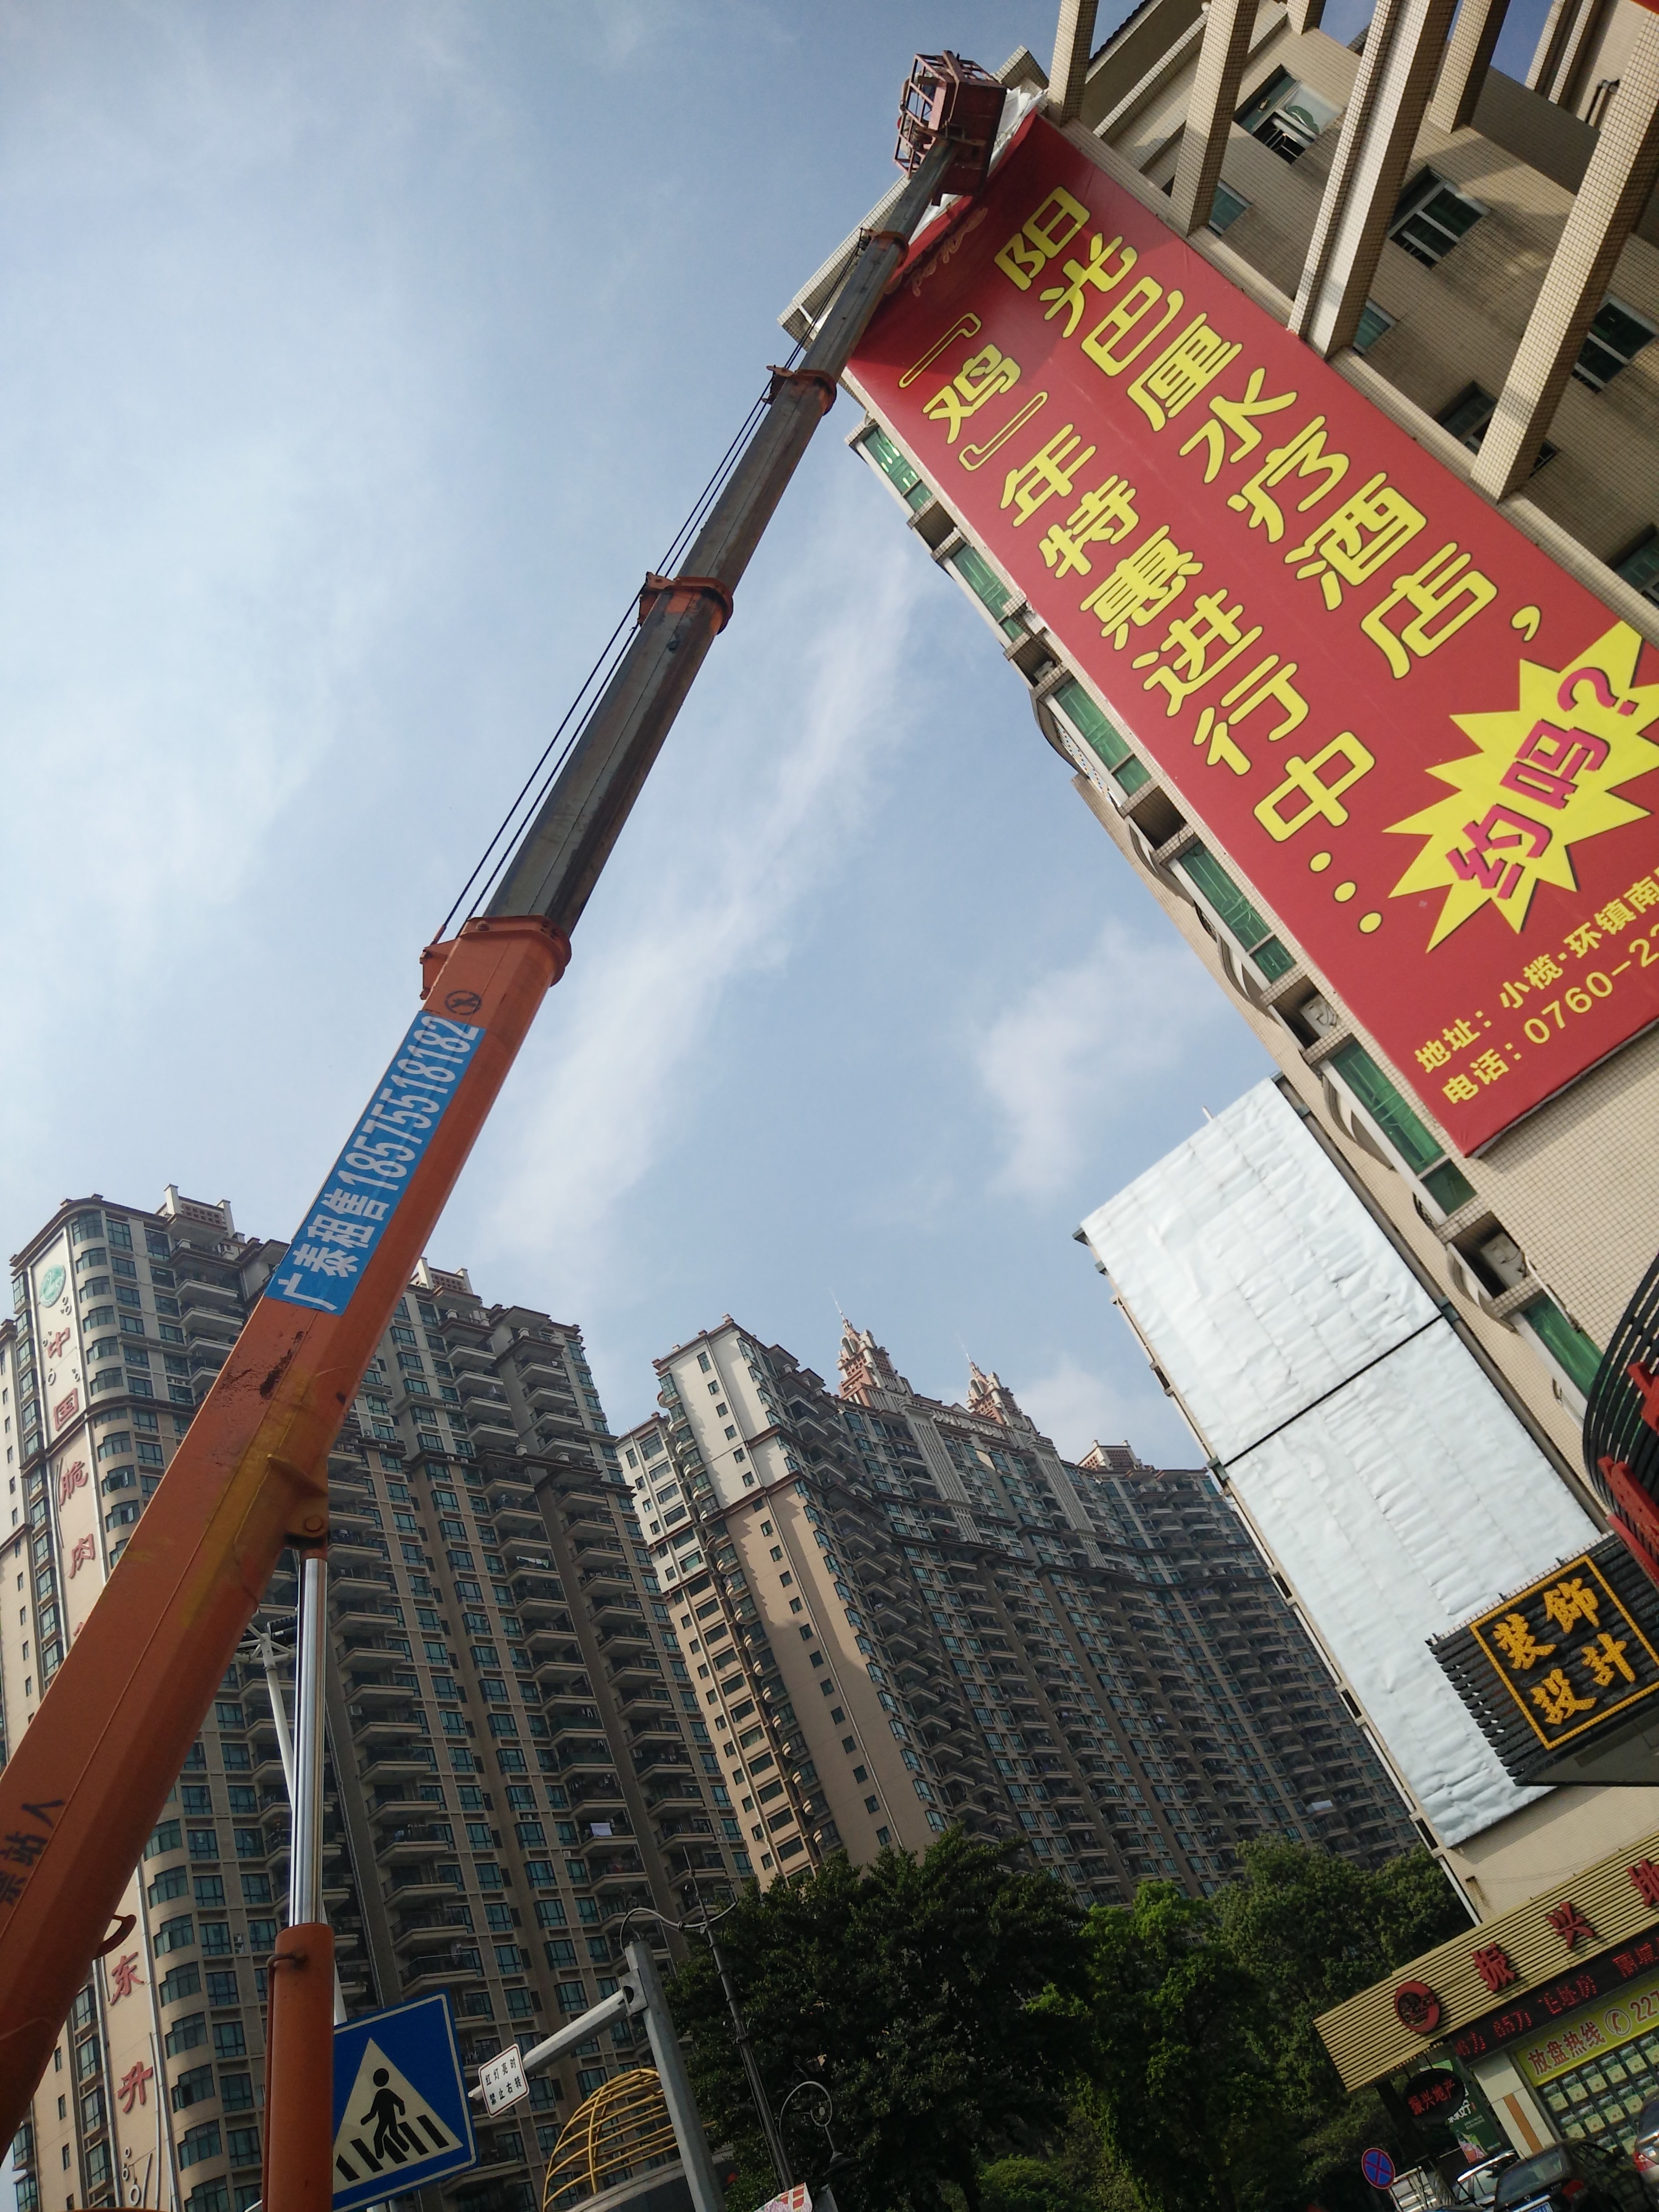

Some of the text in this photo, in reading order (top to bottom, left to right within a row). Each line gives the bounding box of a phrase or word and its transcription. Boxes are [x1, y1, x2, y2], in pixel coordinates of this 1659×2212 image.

[1414, 866, 1659, 1074] 地址：小榄·环镇南
[1528, 2021, 1606, 2075] 放盘热线
[485, 2056, 516, 2086] 红灯亮时
[489, 2075, 522, 2106] 禁止右转
[1408, 2078, 1455, 2116] 振兴地产
